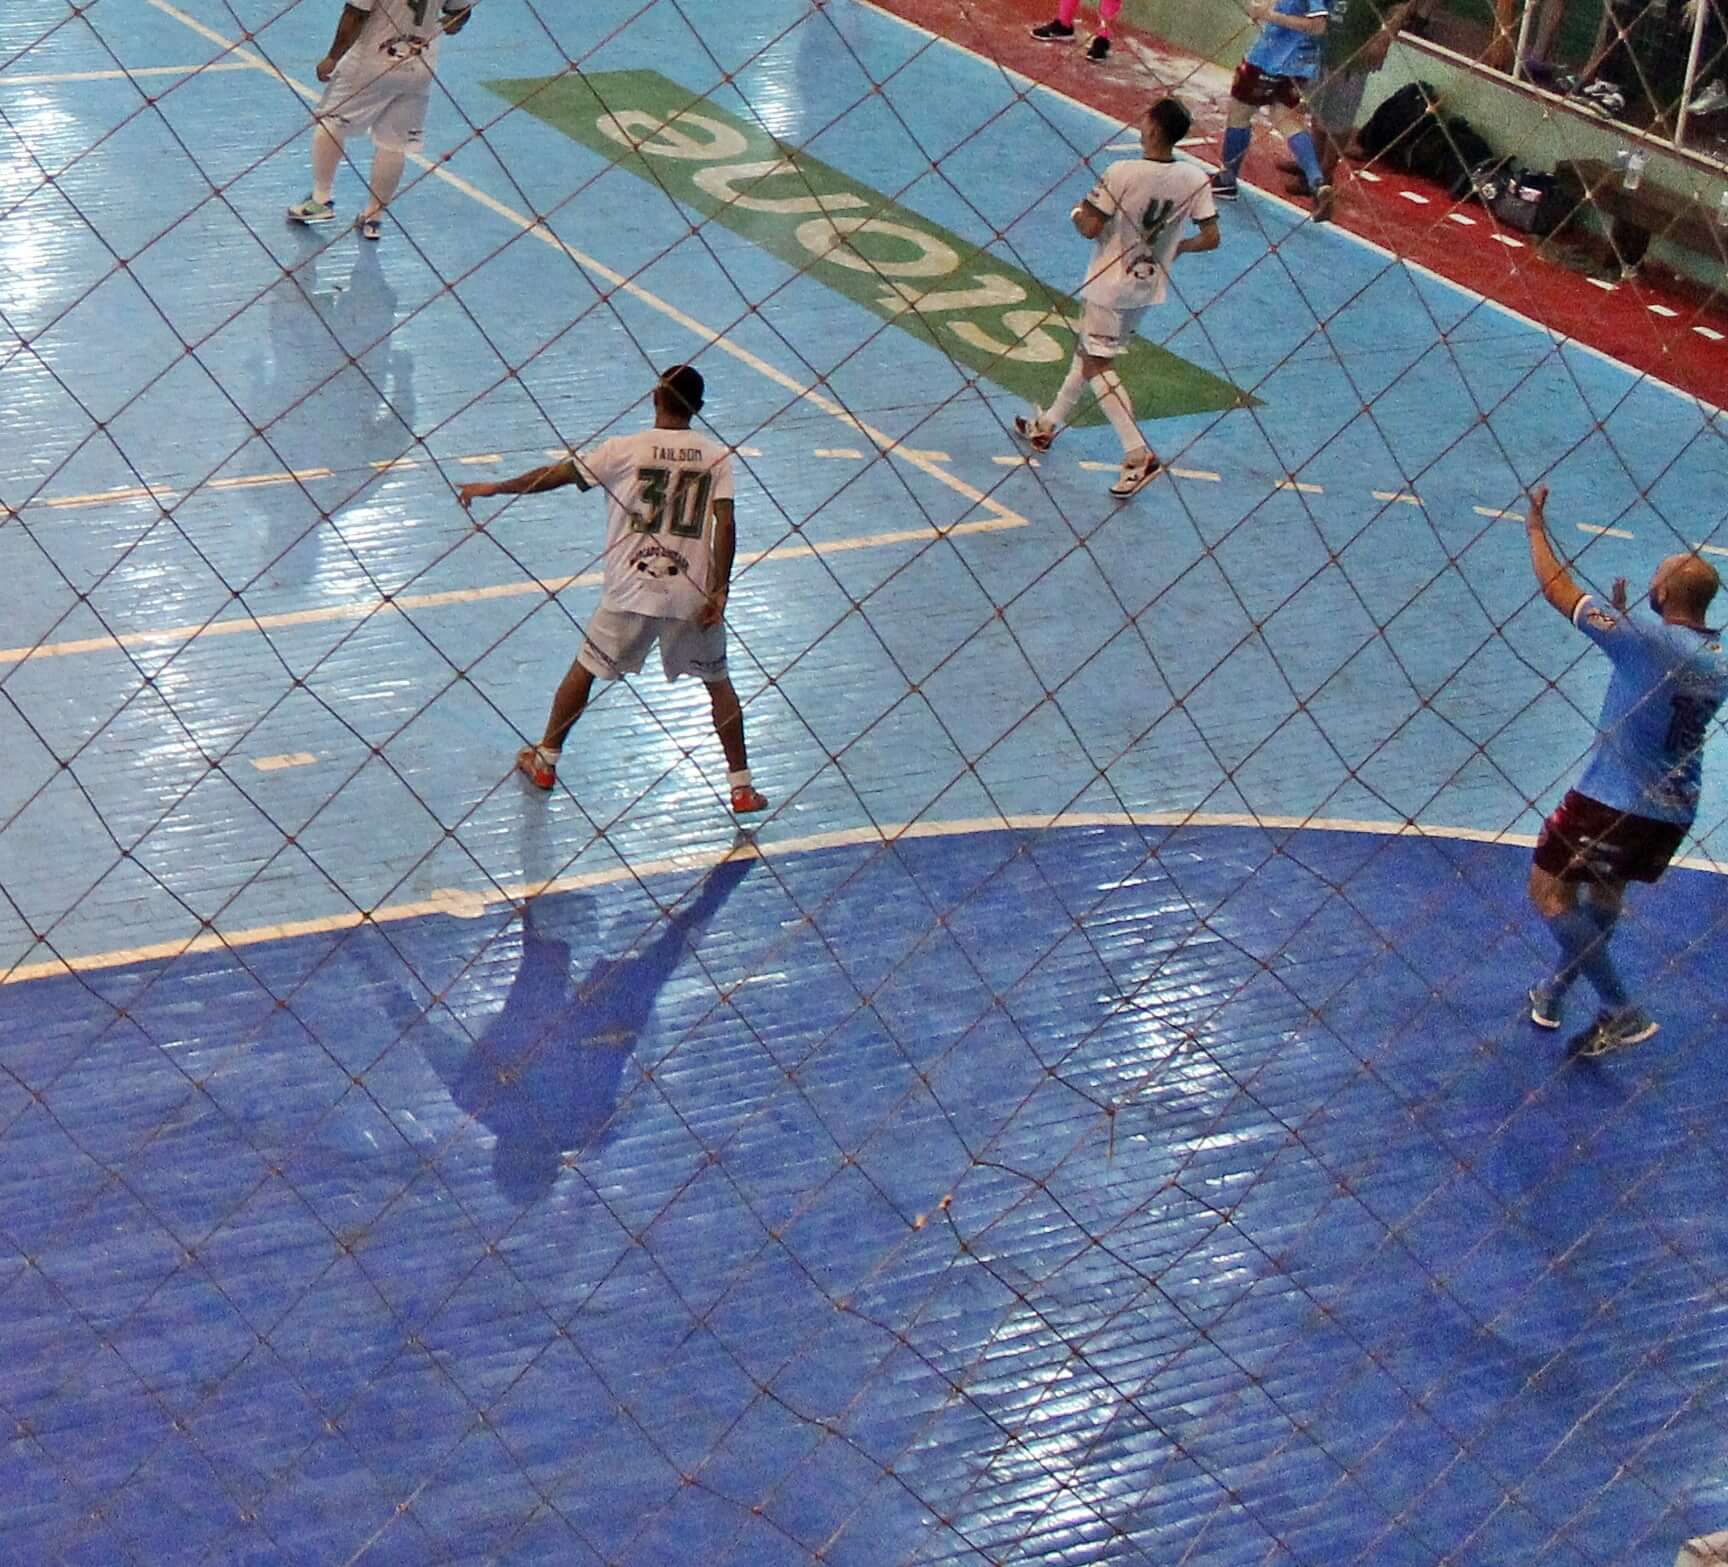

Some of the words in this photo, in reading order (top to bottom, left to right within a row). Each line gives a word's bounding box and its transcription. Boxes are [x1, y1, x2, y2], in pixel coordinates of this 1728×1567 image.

[595, 108, 1086, 365] stone
[651, 445, 704, 462] TAILSON
[631, 467, 712, 540] 30
